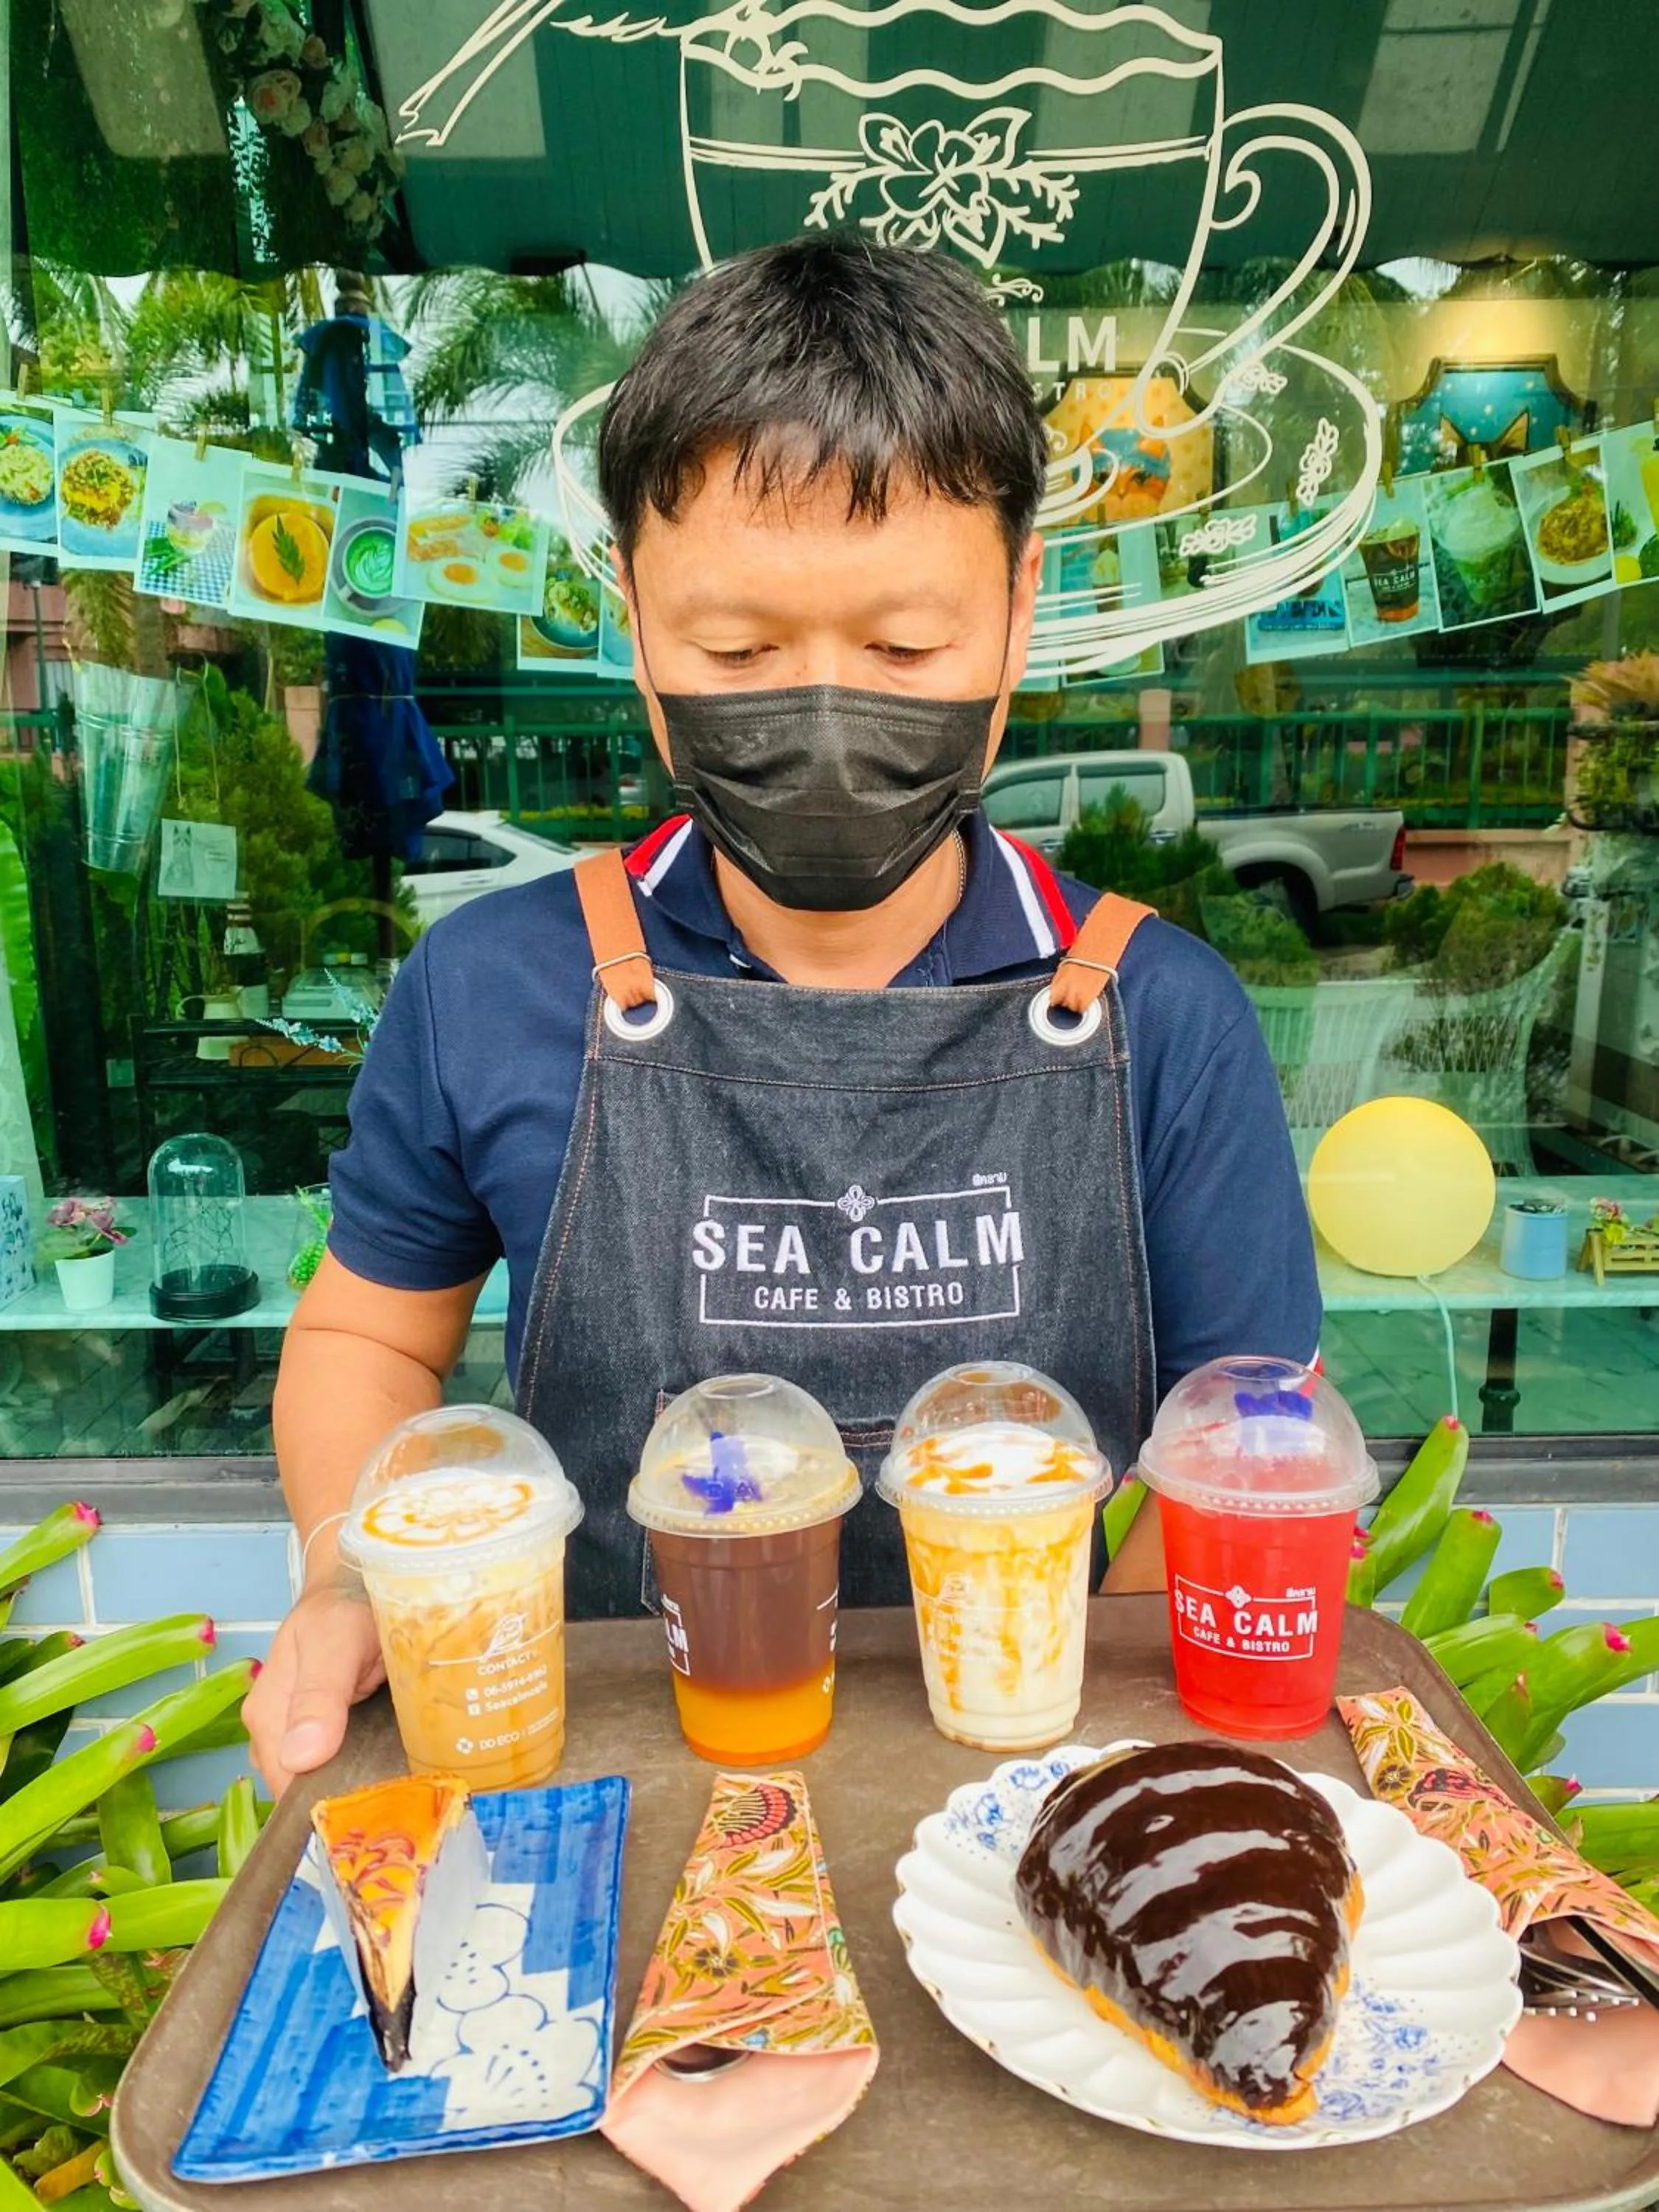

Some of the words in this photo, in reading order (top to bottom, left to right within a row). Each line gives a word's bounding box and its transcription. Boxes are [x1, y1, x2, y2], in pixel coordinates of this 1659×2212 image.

[1000, 316, 1117, 372] LM
[692, 1220, 811, 1275] SEA
[849, 1211, 1024, 1275] CALM
[754, 1286, 818, 1310] CAFE
[834, 1287, 852, 1310] &
[866, 1282, 964, 1310] BISTRO
[1175, 1589, 1217, 1629] SEA
[1234, 1610, 1318, 1637] CALM
[1193, 1625, 1221, 1645] CAFE
[1226, 1636, 1236, 1648] &
[1242, 1639, 1290, 1652] BISTRO
